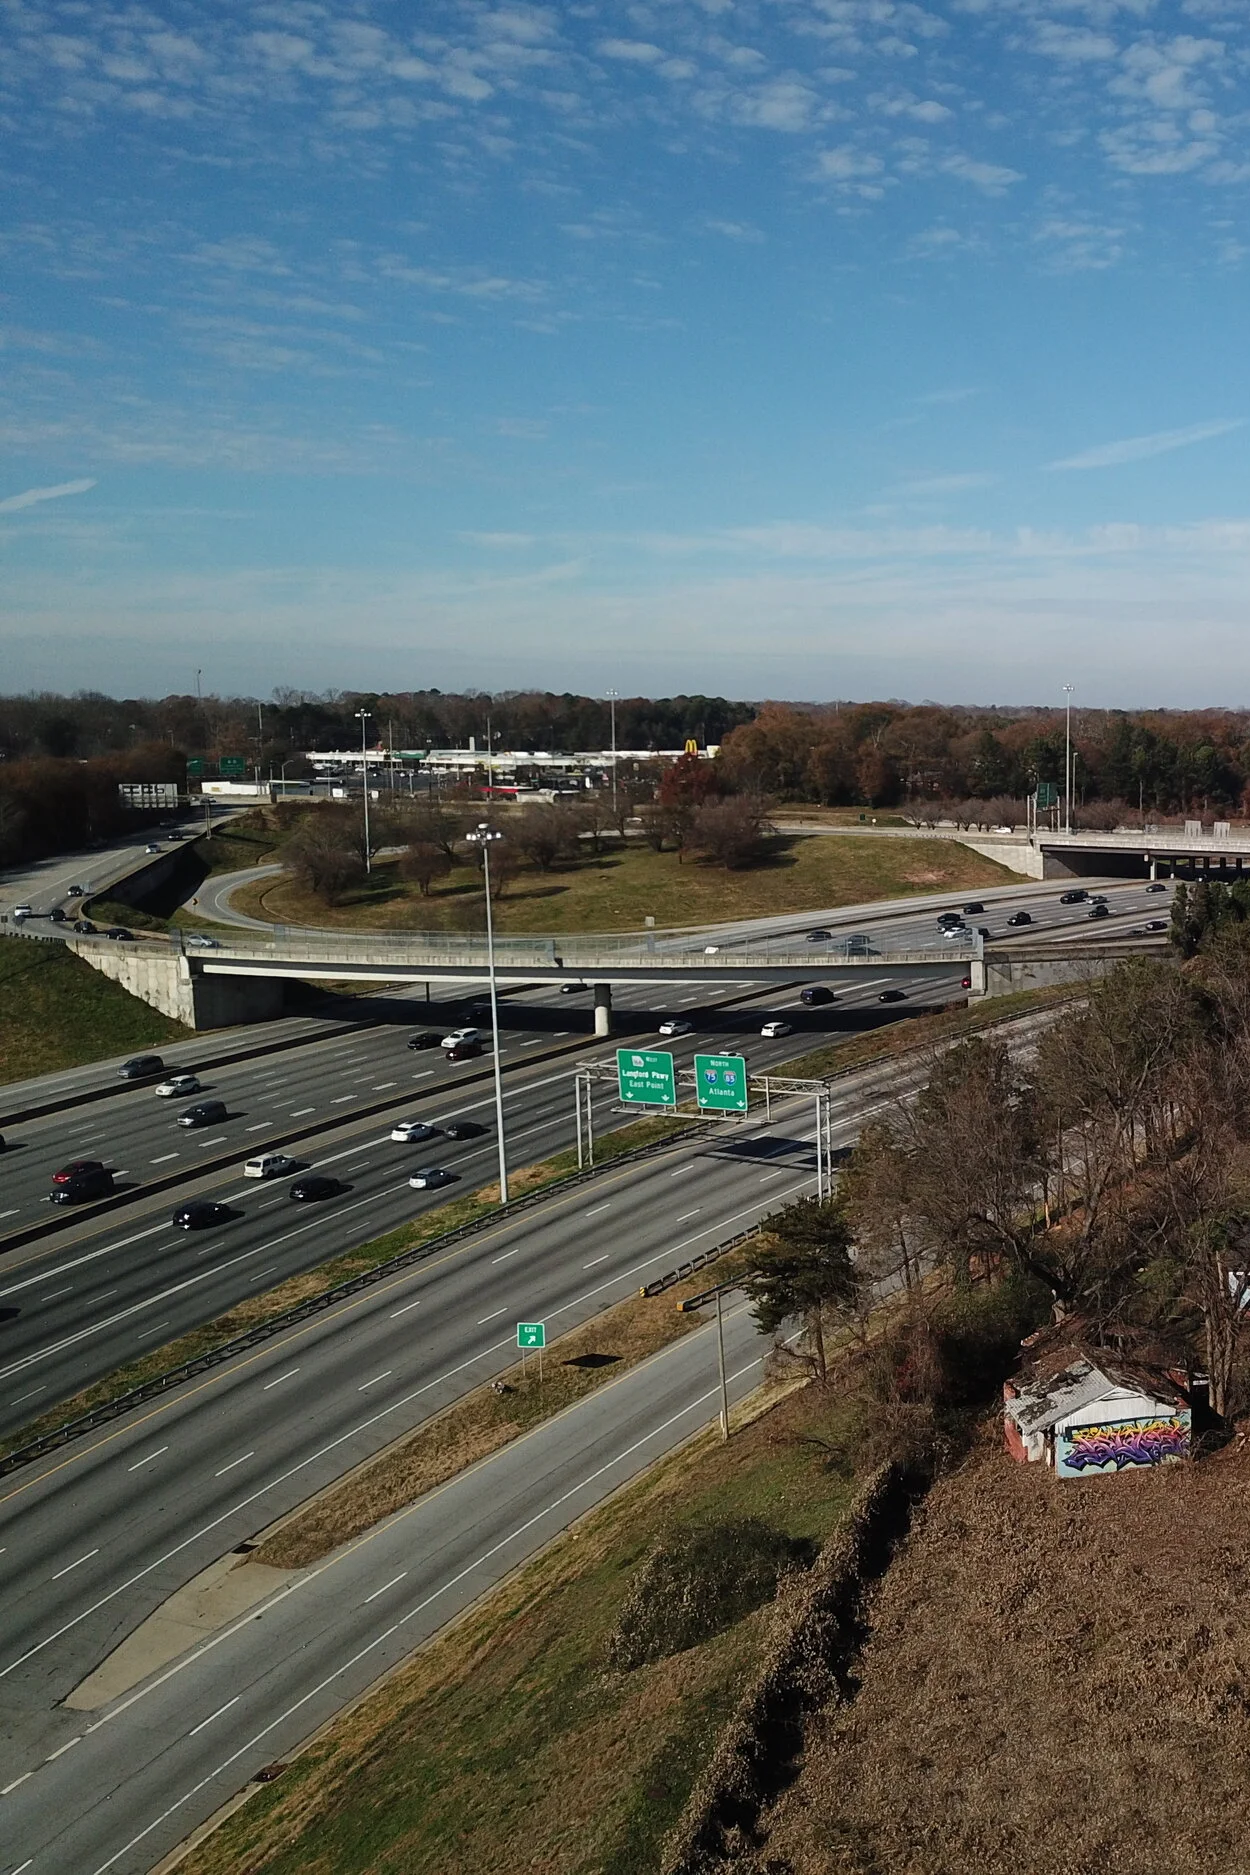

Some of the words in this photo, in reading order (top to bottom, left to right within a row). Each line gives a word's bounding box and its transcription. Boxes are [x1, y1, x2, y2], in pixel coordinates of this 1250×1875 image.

[622, 1069, 649, 1079] Langford
[651, 1071, 669, 1081] Pkwy
[707, 1073, 716, 1081] 75
[725, 1075, 735, 1083] 85
[629, 1080, 644, 1088] East
[646, 1081, 664, 1089] Point
[709, 1088, 735, 1097] Atlanta
